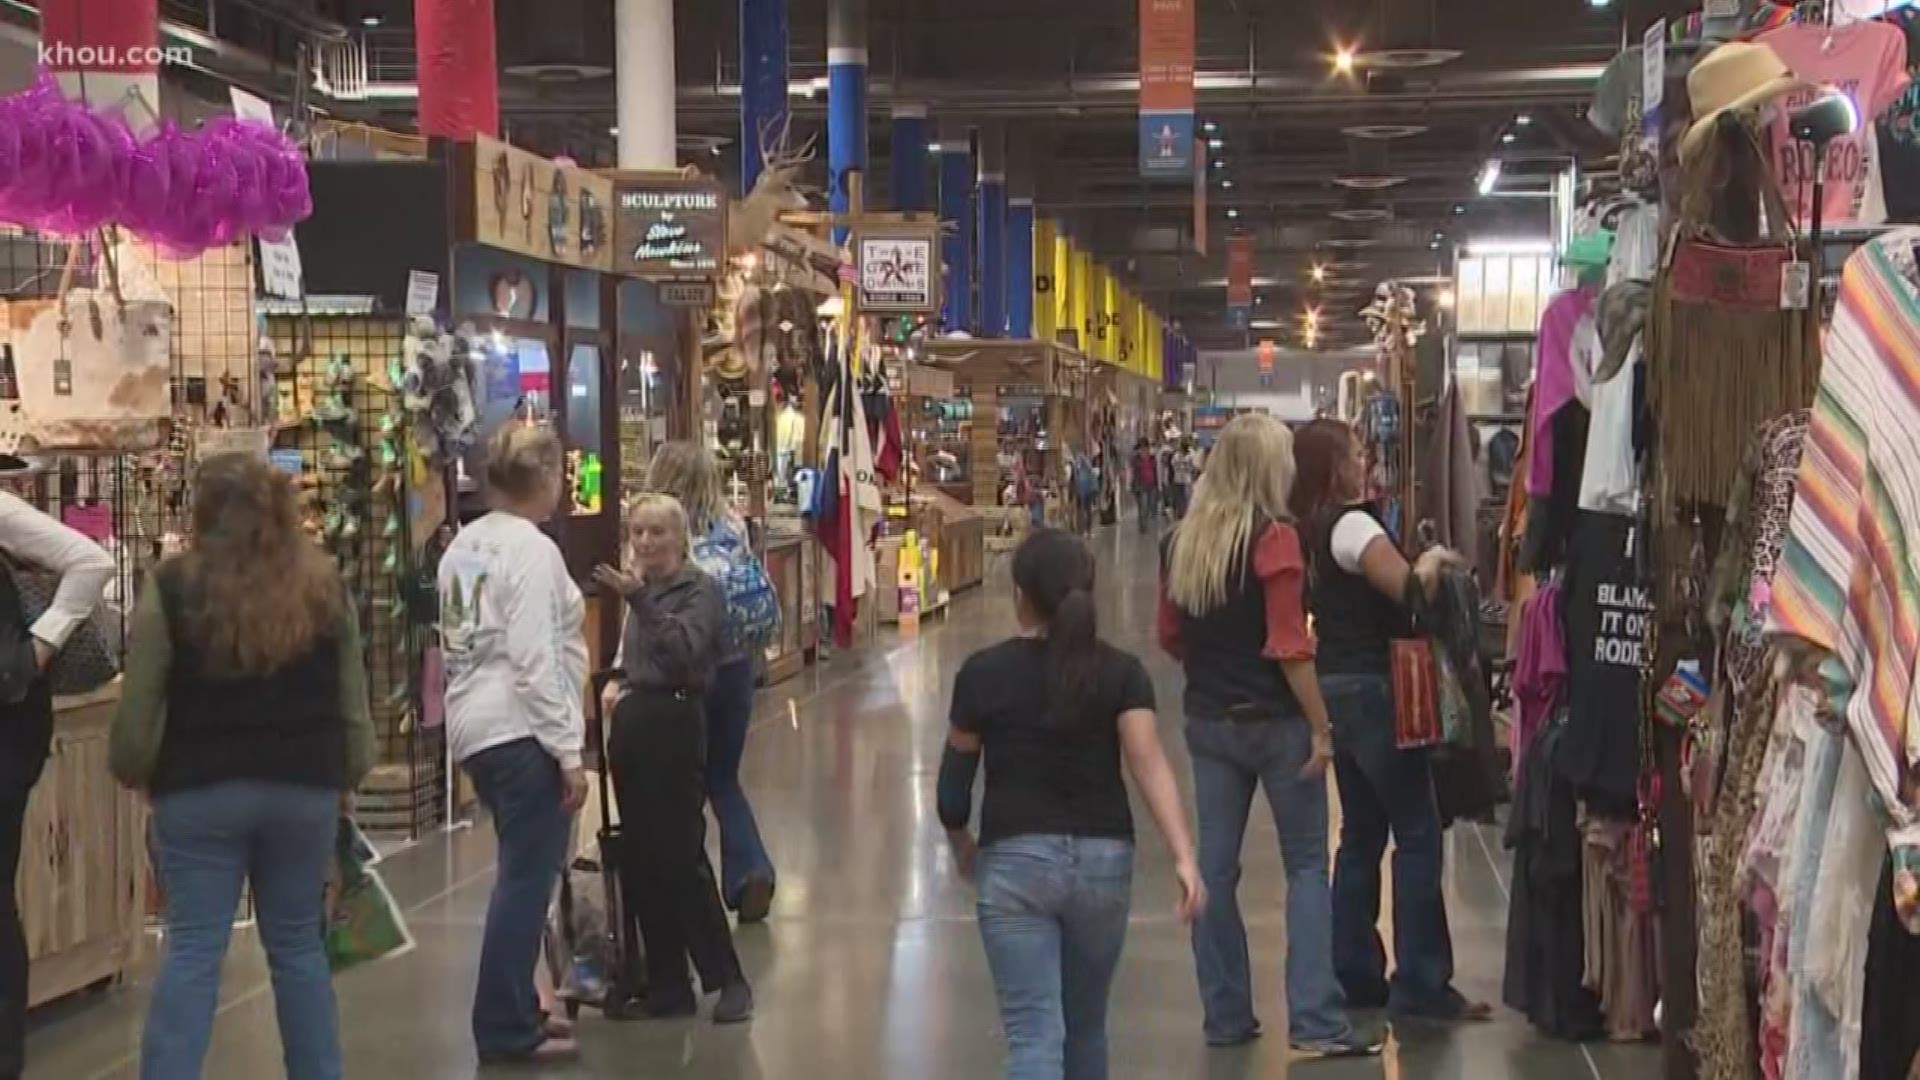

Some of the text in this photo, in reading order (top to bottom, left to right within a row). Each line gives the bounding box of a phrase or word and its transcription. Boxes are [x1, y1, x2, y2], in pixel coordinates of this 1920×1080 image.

[1780, 141, 1859, 184] ROEO
[621, 193, 717, 209] SCULPTURE
[660, 210, 675, 222] by
[634, 240, 701, 260] Hawkins
[1625, 527, 1635, 557] I
[1597, 583, 1656, 609] BLAM
[1600, 611, 1623, 633] IT
[1594, 636, 1644, 666] RODE
